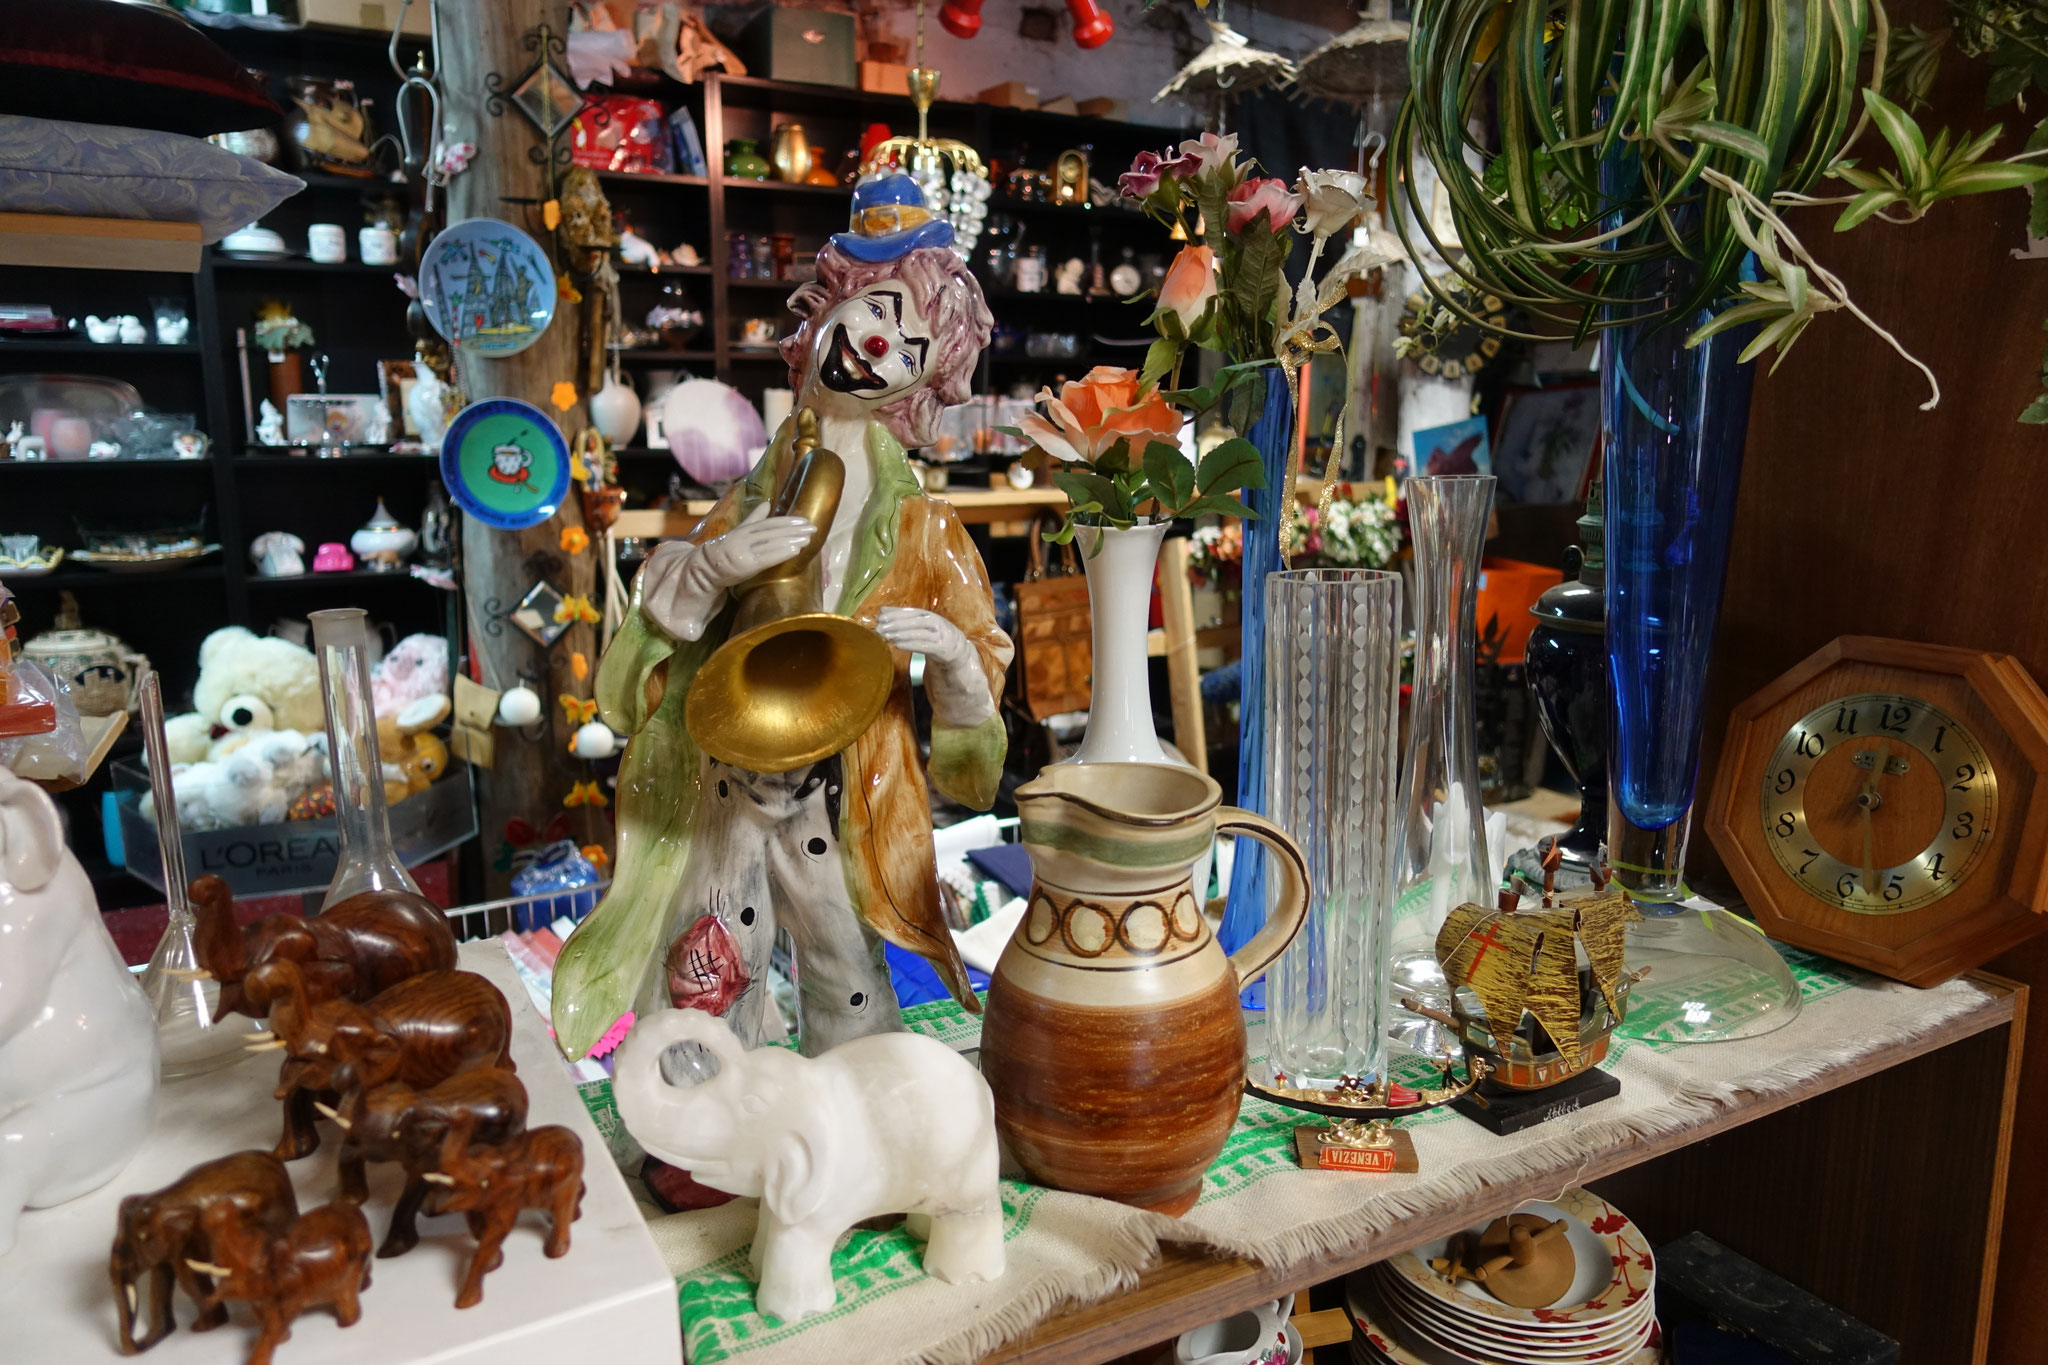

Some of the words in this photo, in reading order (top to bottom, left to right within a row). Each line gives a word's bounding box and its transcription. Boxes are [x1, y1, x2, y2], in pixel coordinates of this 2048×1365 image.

[1833, 707, 1858, 735] 11
[1879, 704, 1911, 733] 12
[1793, 730, 1824, 759] 10
[1931, 726, 1946, 753] 1
[1775, 768, 1796, 795] 9
[1952, 764, 1975, 792] 2
[1775, 812, 1796, 838] 8
[1952, 811, 1974, 840] 3
[255, 863, 313, 878] PARIS
[1799, 848, 1820, 875] 7
[1923, 852, 1947, 882] 4
[1836, 872, 1860, 899] 6
[1882, 874, 1905, 902] 5
[1331, 1149, 1380, 1166] VENEZIA
